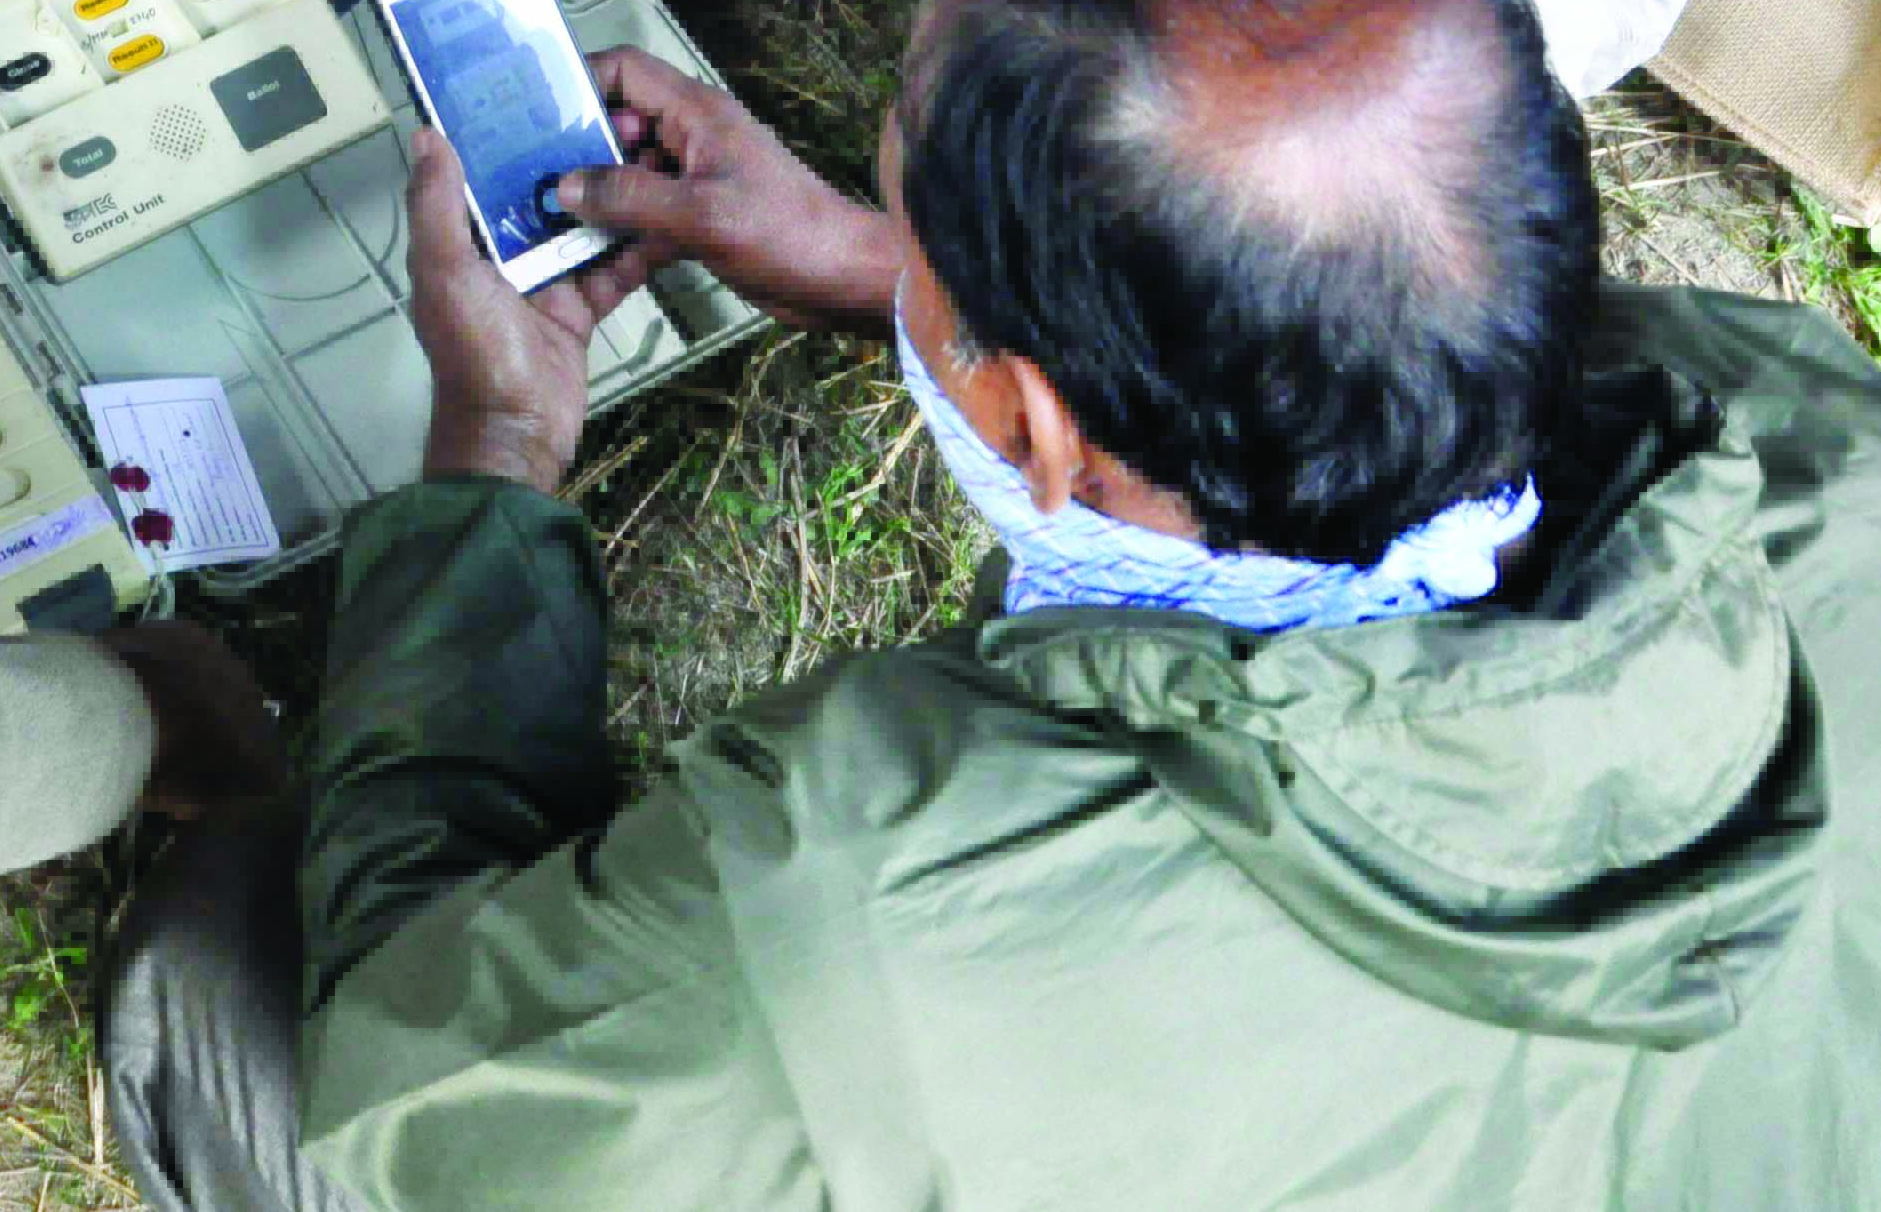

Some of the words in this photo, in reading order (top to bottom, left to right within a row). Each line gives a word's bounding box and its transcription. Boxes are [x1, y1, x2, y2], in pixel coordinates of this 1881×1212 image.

[111, 42, 147, 64] Result
[246, 79, 281, 102] Ballot
[72, 147, 104, 169] Total
[72, 211, 129, 245] Control
[133, 193, 167, 215] Unit
